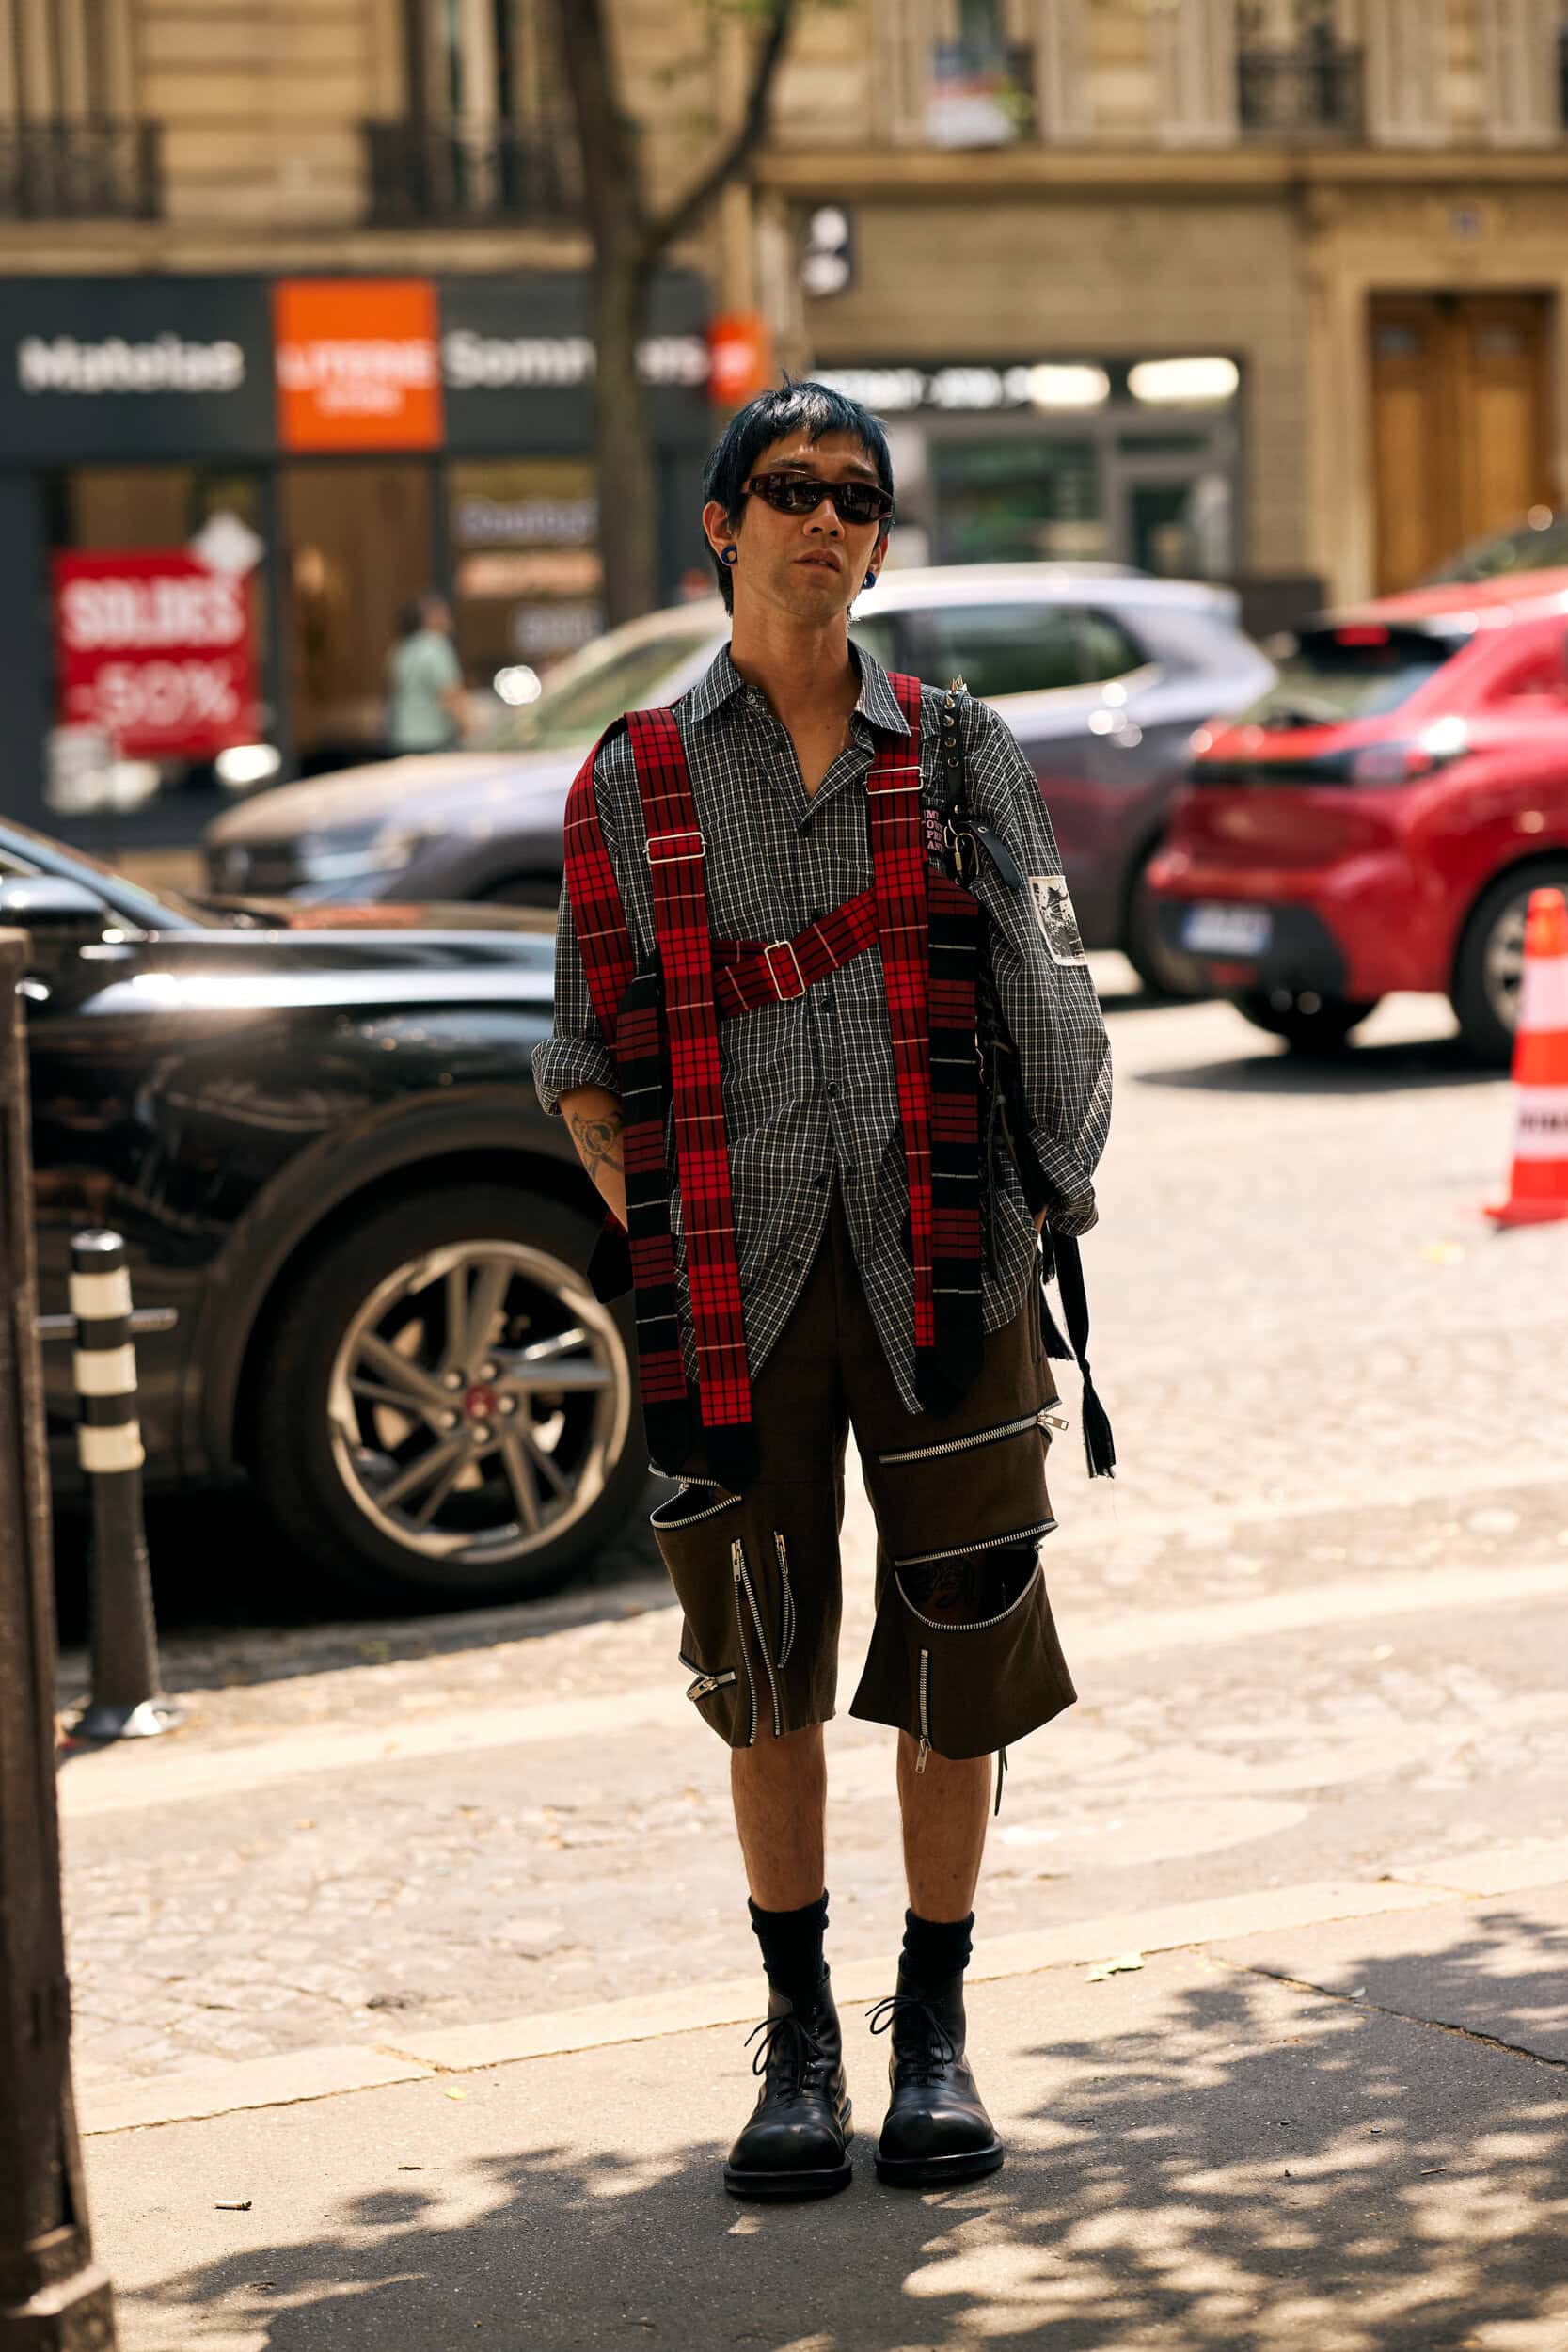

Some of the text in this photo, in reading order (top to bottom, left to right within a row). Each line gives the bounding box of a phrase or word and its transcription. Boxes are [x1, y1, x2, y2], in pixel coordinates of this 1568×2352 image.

[19, 335, 245, 392] Matelas
[63, 576, 245, 649] SOLDES
[66, 660, 240, 726] -50%
